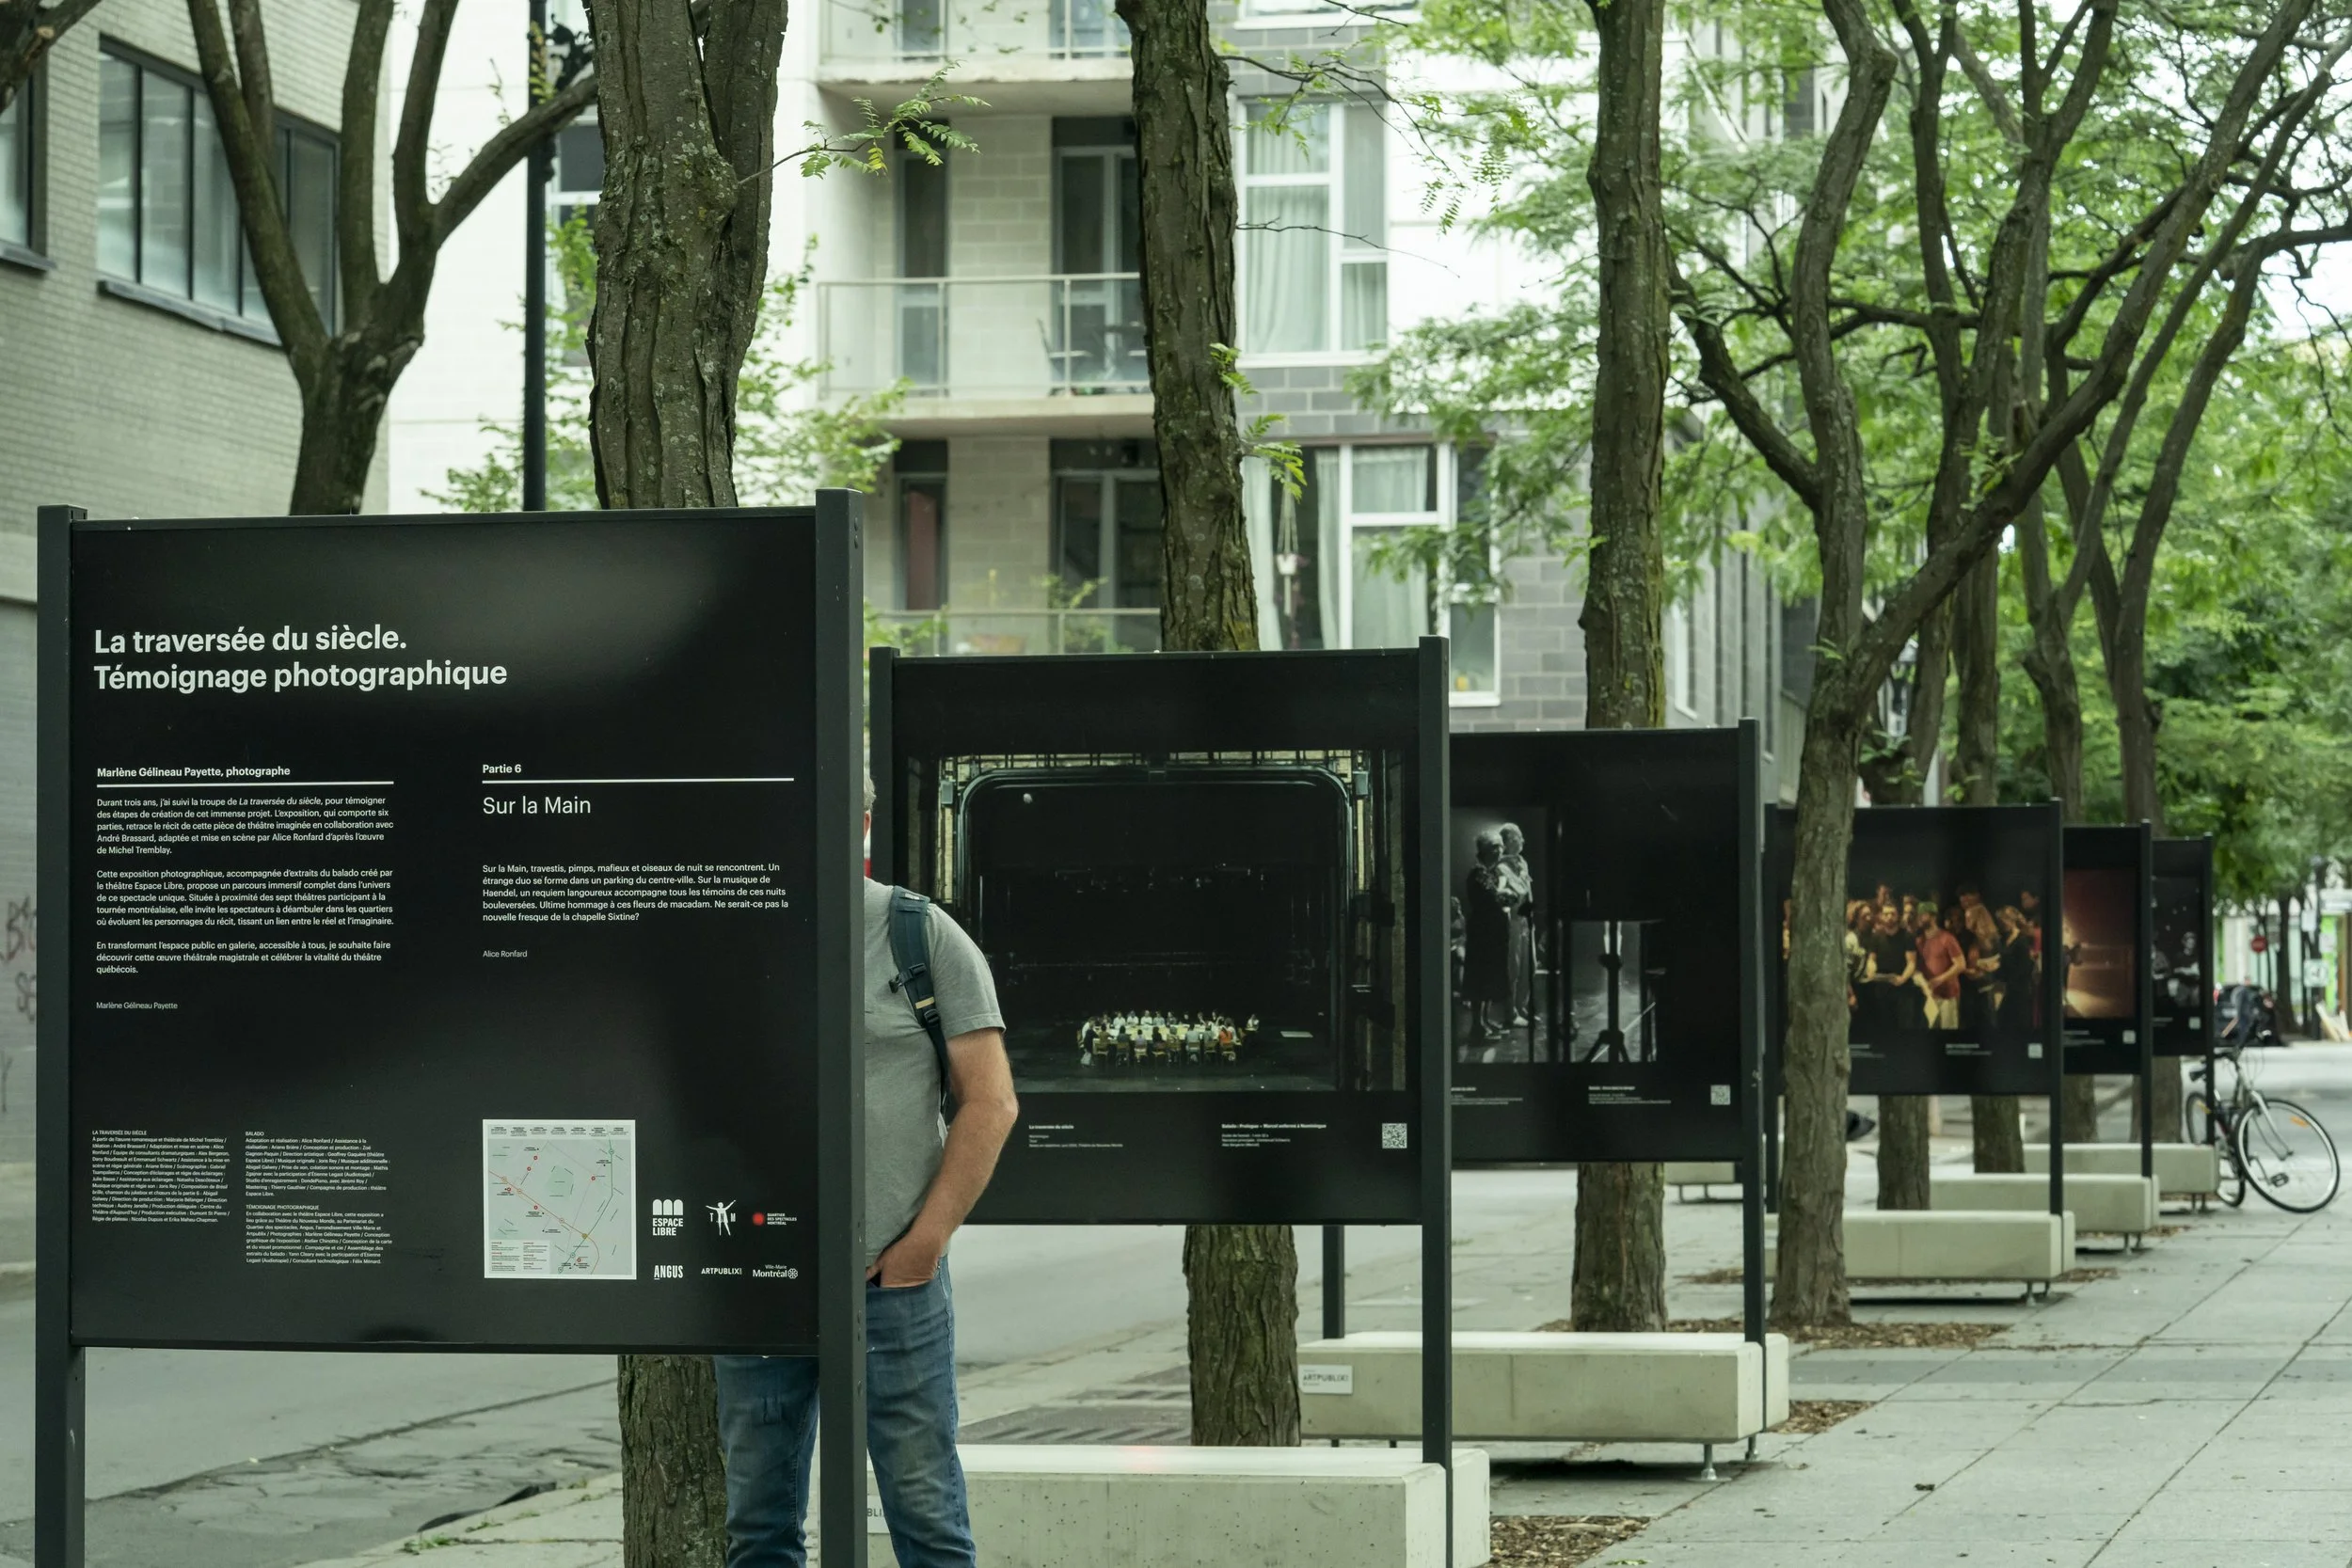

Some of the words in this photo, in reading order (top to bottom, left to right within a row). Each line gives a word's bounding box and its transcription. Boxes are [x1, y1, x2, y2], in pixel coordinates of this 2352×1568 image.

[95, 630, 125, 653] La
[133, 626, 265, 653] traversée
[272, 626, 308, 651] du
[315, 624, 406, 650] siècle.
[94, 662, 267, 693] Témoignage
[275, 659, 507, 691] photographique
[97, 768, 137, 777] Marlène
[138, 768, 183, 777] Gélineau
[184, 768, 224, 778] Payette,
[226, 766, 291, 777] photographe
[483, 764, 513, 773] Partie
[515, 764, 521, 773] 6
[160, 799, 170, 807] j'ai
[172, 798, 190, 806] suivi
[199, 799, 226, 807] troupe
[287, 797, 297, 805] du
[298, 797, 323, 805] siècle,
[345, 796, 386, 806] témoigner
[484, 797, 516, 815] Sur
[523, 796, 537, 814] la
[546, 796, 591, 814] Main
[112, 811, 138, 819] étapes
[140, 810, 150, 818] de
[151, 810, 183, 818] création
[247, 809, 273, 818] projet.
[275, 809, 322, 818] L'exposition,
[324, 809, 336, 818] qui
[97, 823, 124, 832] parties,
[214, 822, 234, 831] pièce
[236, 821, 246, 830] de
[247, 821, 275, 830] théâtre
[277, 821, 311, 831] imaginée
[324, 820, 374, 829] collaboration
[121, 834, 156, 843] Brassard,
[158, 833, 190, 843] adaptée
[201, 833, 219, 842] mise
[294, 832, 324, 841] Ronfard
[326, 832, 354, 842] d'après
[356, 832, 384, 841] l'œuvre
[108, 846, 134, 854] Michel
[135, 846, 172, 855] Tremblay.
[499, 864, 505, 873] la
[507, 864, 529, 873] Main,
[531, 864, 566, 873] travestis,
[568, 864, 596, 874] pimps,
[597, 863, 629, 872] mafieux
[642, 863, 673, 872] oiseaux
[675, 863, 685, 872] de
[483, 877, 514, 886] étrange
[532, 876, 543, 884] se
[604, 876, 634, 886] parking
[636, 876, 646, 884] du
[648, 876, 696, 884] centre-ville.
[698, 876, 712, 884] Sur
[723, 876, 758, 885] musique
[759, 875, 771, 883] de
[483, 889, 517, 897] Haendel,
[532, 889, 565, 898] requiem
[567, 888, 612, 898] langoureux
[567, 900, 609, 911] hommage
[610, 900, 615, 909] à
[633, 900, 656, 909] fleurs
[658, 900, 668, 909] de
[670, 900, 712, 909] macadam.
[781, 899, 788, 908] la
[518, 912, 548, 922] fresque
[550, 912, 561, 921] de
[563, 912, 570, 921] la
[572, 912, 606, 922] chapelle
[608, 912, 640, 921] Sixtine?
[153, 1002, 178, 1010] Payette
[653, 1218, 683, 1227] ESPACE
[653, 1227, 676, 1236] LIBRE
[654, 1265, 683, 1279] ANGUS
[753, 1269, 787, 1277] Montréal
